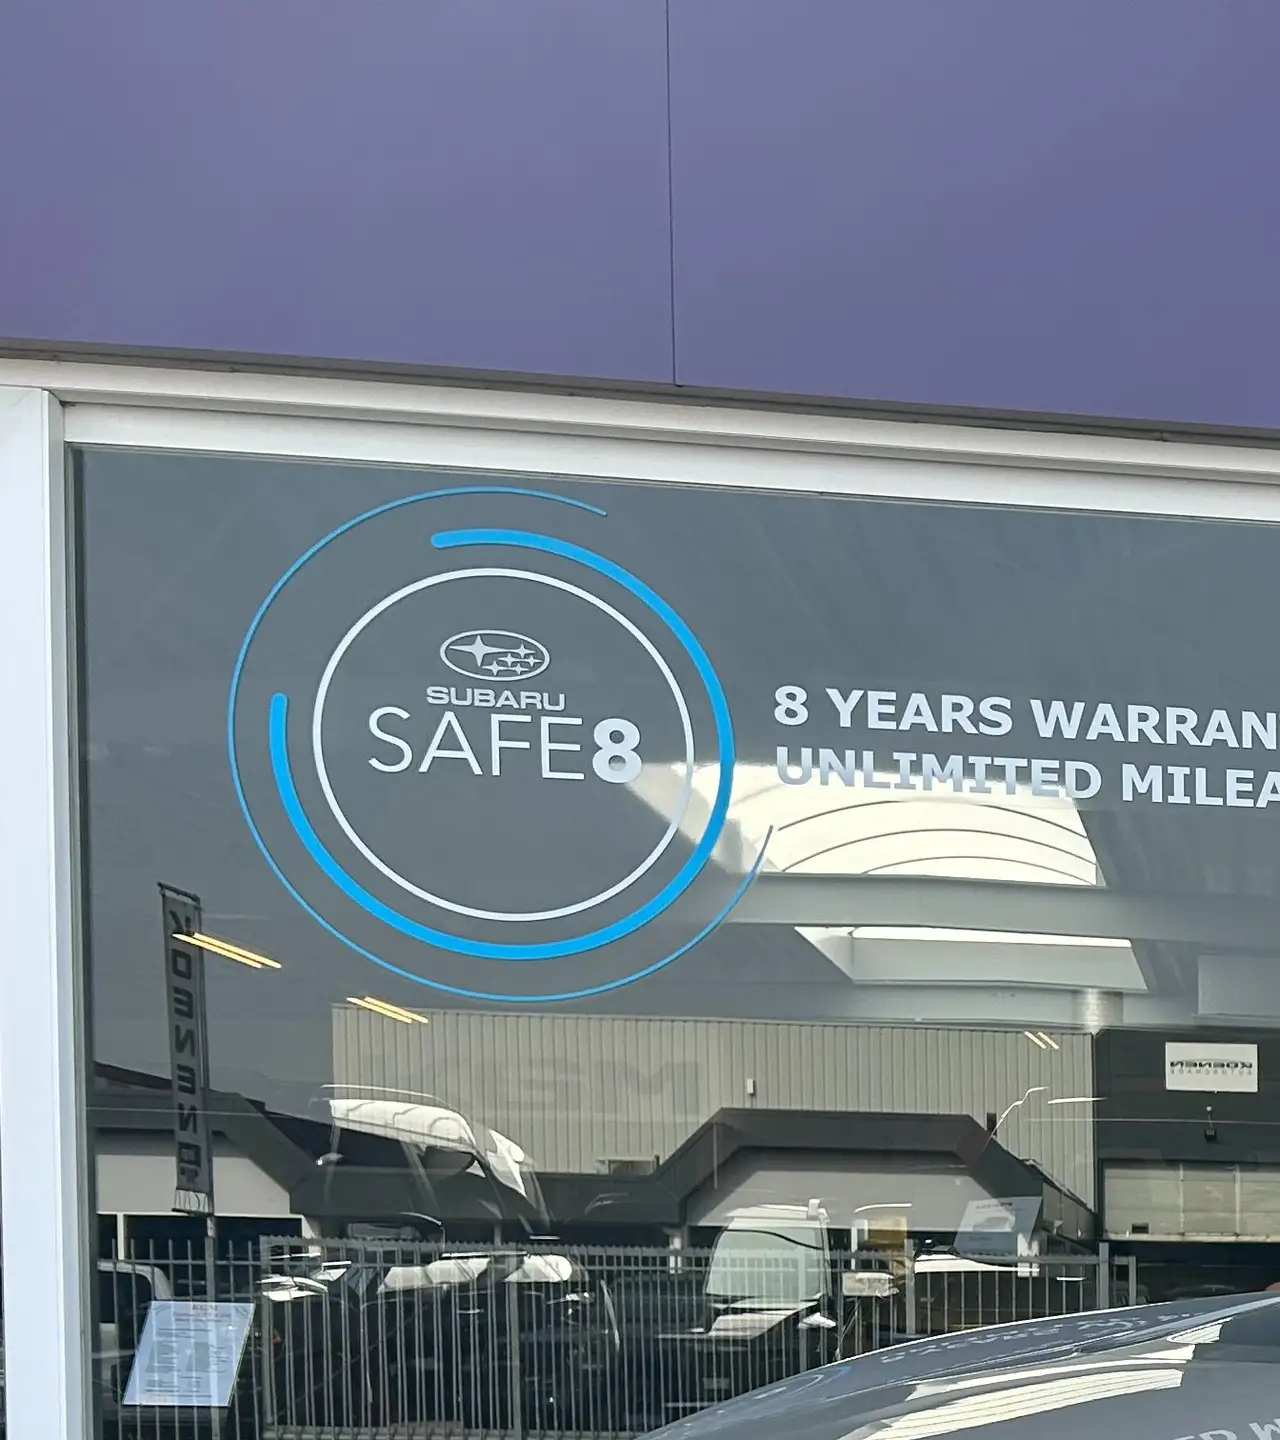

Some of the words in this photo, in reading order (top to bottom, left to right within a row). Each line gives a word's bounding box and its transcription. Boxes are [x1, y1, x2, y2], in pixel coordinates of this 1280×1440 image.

[425, 685, 567, 712] SUBARU
[773, 684, 809, 727] 8
[825, 687, 1013, 737] YEARS
[367, 705, 643, 784] SAFE8
[776, 745, 1102, 799] UNLIMITED
